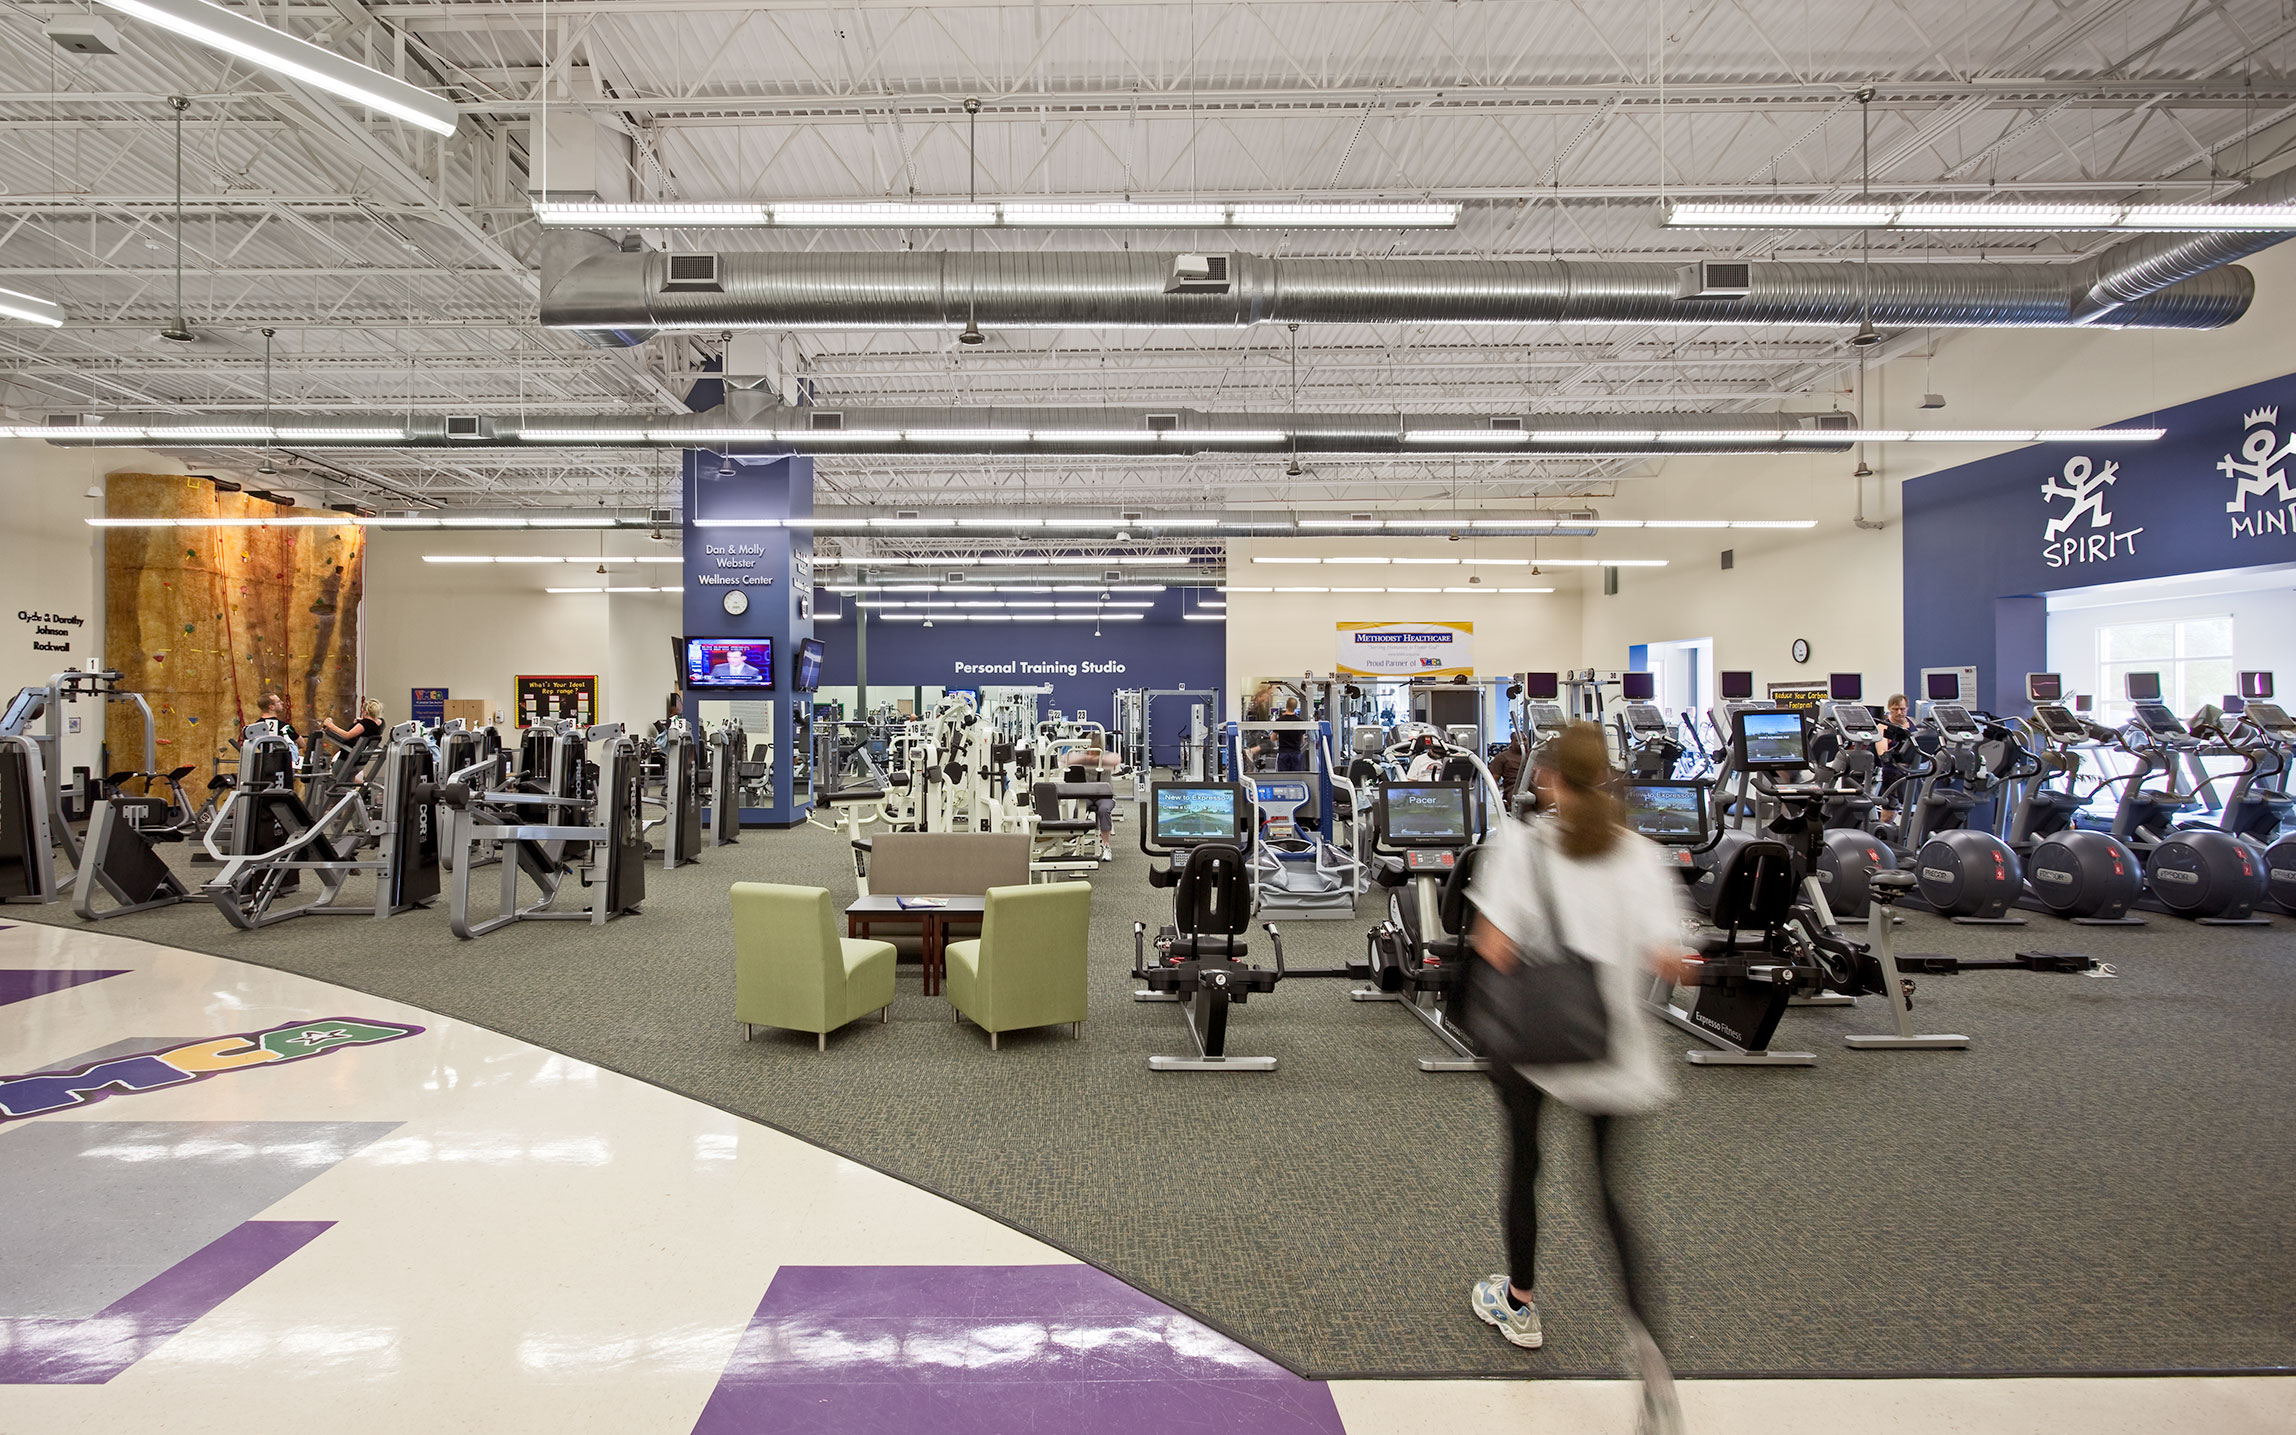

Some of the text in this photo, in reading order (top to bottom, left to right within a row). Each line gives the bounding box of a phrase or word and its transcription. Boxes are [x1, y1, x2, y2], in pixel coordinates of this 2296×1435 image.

[706, 544, 765, 558] Dan & Molly
[2042, 527, 2144, 567] SPIRIT
[716, 557, 756, 569] Webster
[698, 574, 773, 585] Wellness Center
[53, 614, 84, 628] Dorothy
[35, 625, 69, 636] Johnson
[1357, 633, 1452, 642] METHODIST HEALTHCARE
[33, 641, 70, 652] Rockwall
[91, 659, 95, 670] 1
[955, 660, 1126, 677] Personal Training Studio
[415, 690, 443, 700] YMCA
[1789, 701, 1813, 709] Footprint
[924, 711, 931, 719] 17
[1054, 711, 1061, 719] 22
[1078, 711, 1086, 720] 23
[268, 721, 275, 732] 2
[410, 722, 416, 733] 3
[620, 722, 626, 734] 4
[911, 724, 919, 733] 16
[1409, 796, 1437, 804] Pacer
[1924, 868, 1948, 880] PRECOR
[1695, 1010, 1743, 1041] Expresso Fitness
